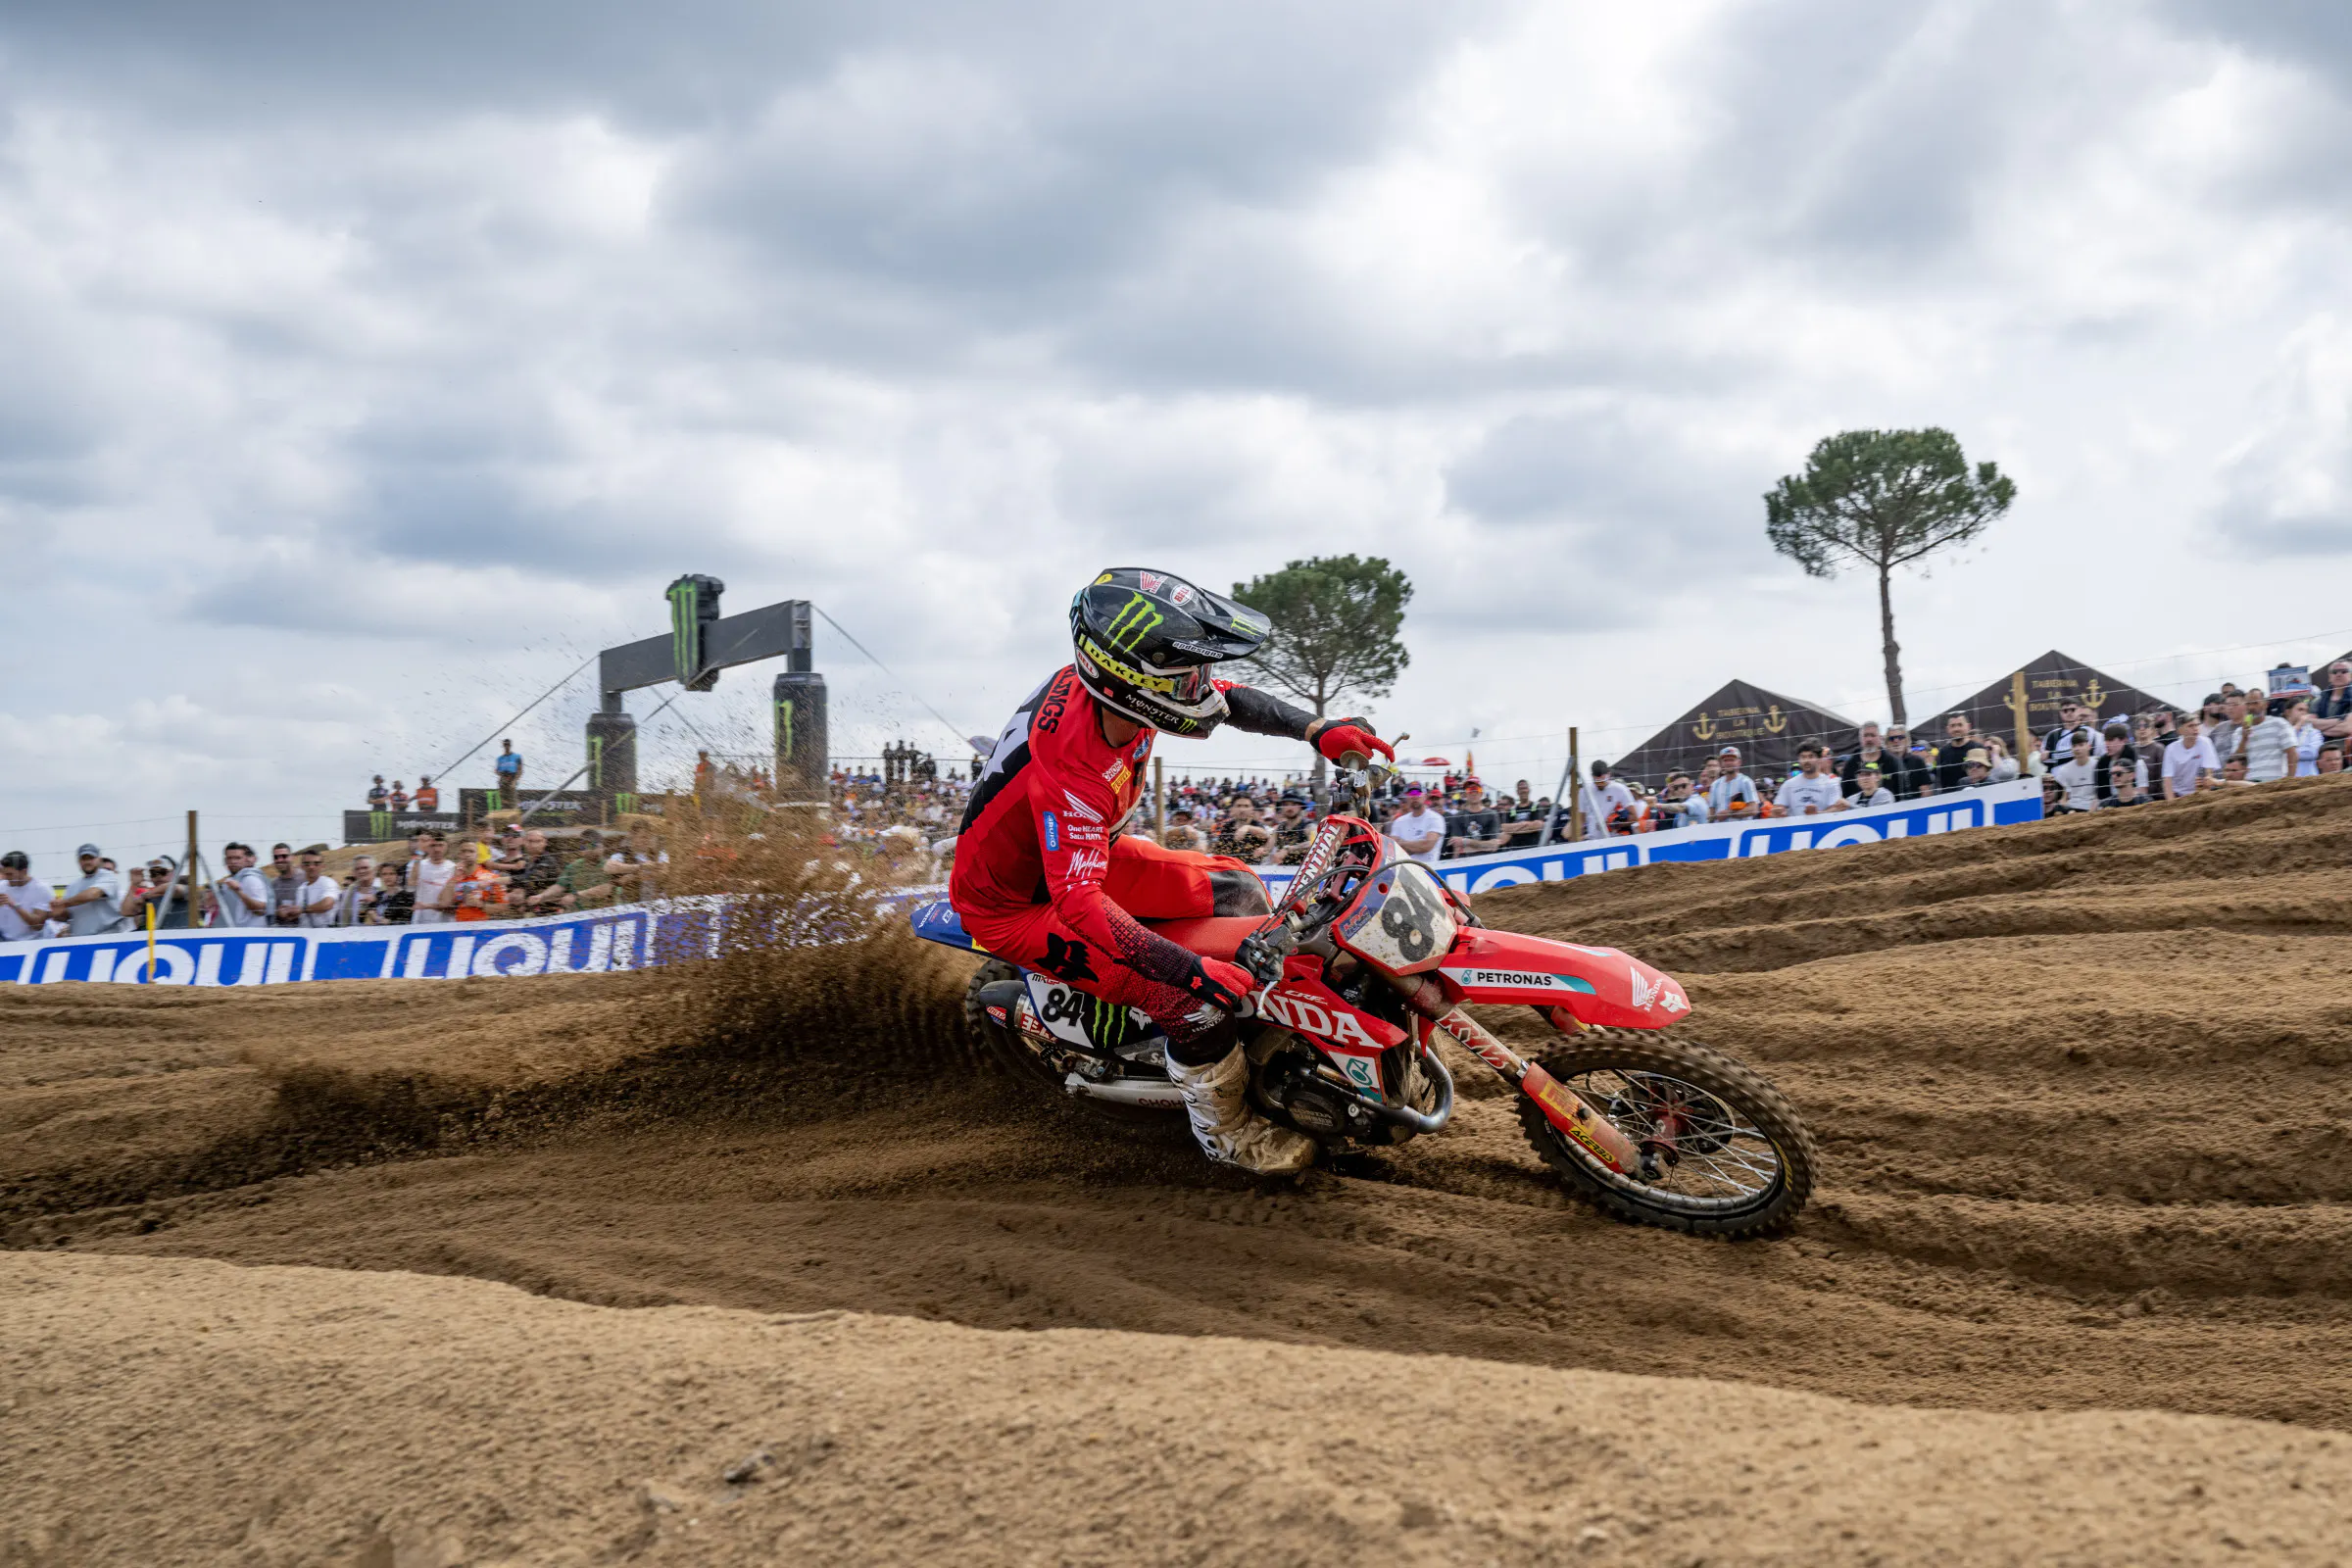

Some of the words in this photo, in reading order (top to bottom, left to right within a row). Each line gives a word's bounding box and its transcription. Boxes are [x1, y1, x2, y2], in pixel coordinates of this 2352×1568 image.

[1172, 641, 1224, 659] apdesigns
[1090, 648, 1162, 687] OAKLEY
[1125, 694, 1180, 724] MONSTER
[1067, 824, 1082, 833] One
[1477, 971, 1552, 987] PETRONAS
[1042, 988, 1085, 1027] 84
[1643, 978, 1663, 1012] HONDA
